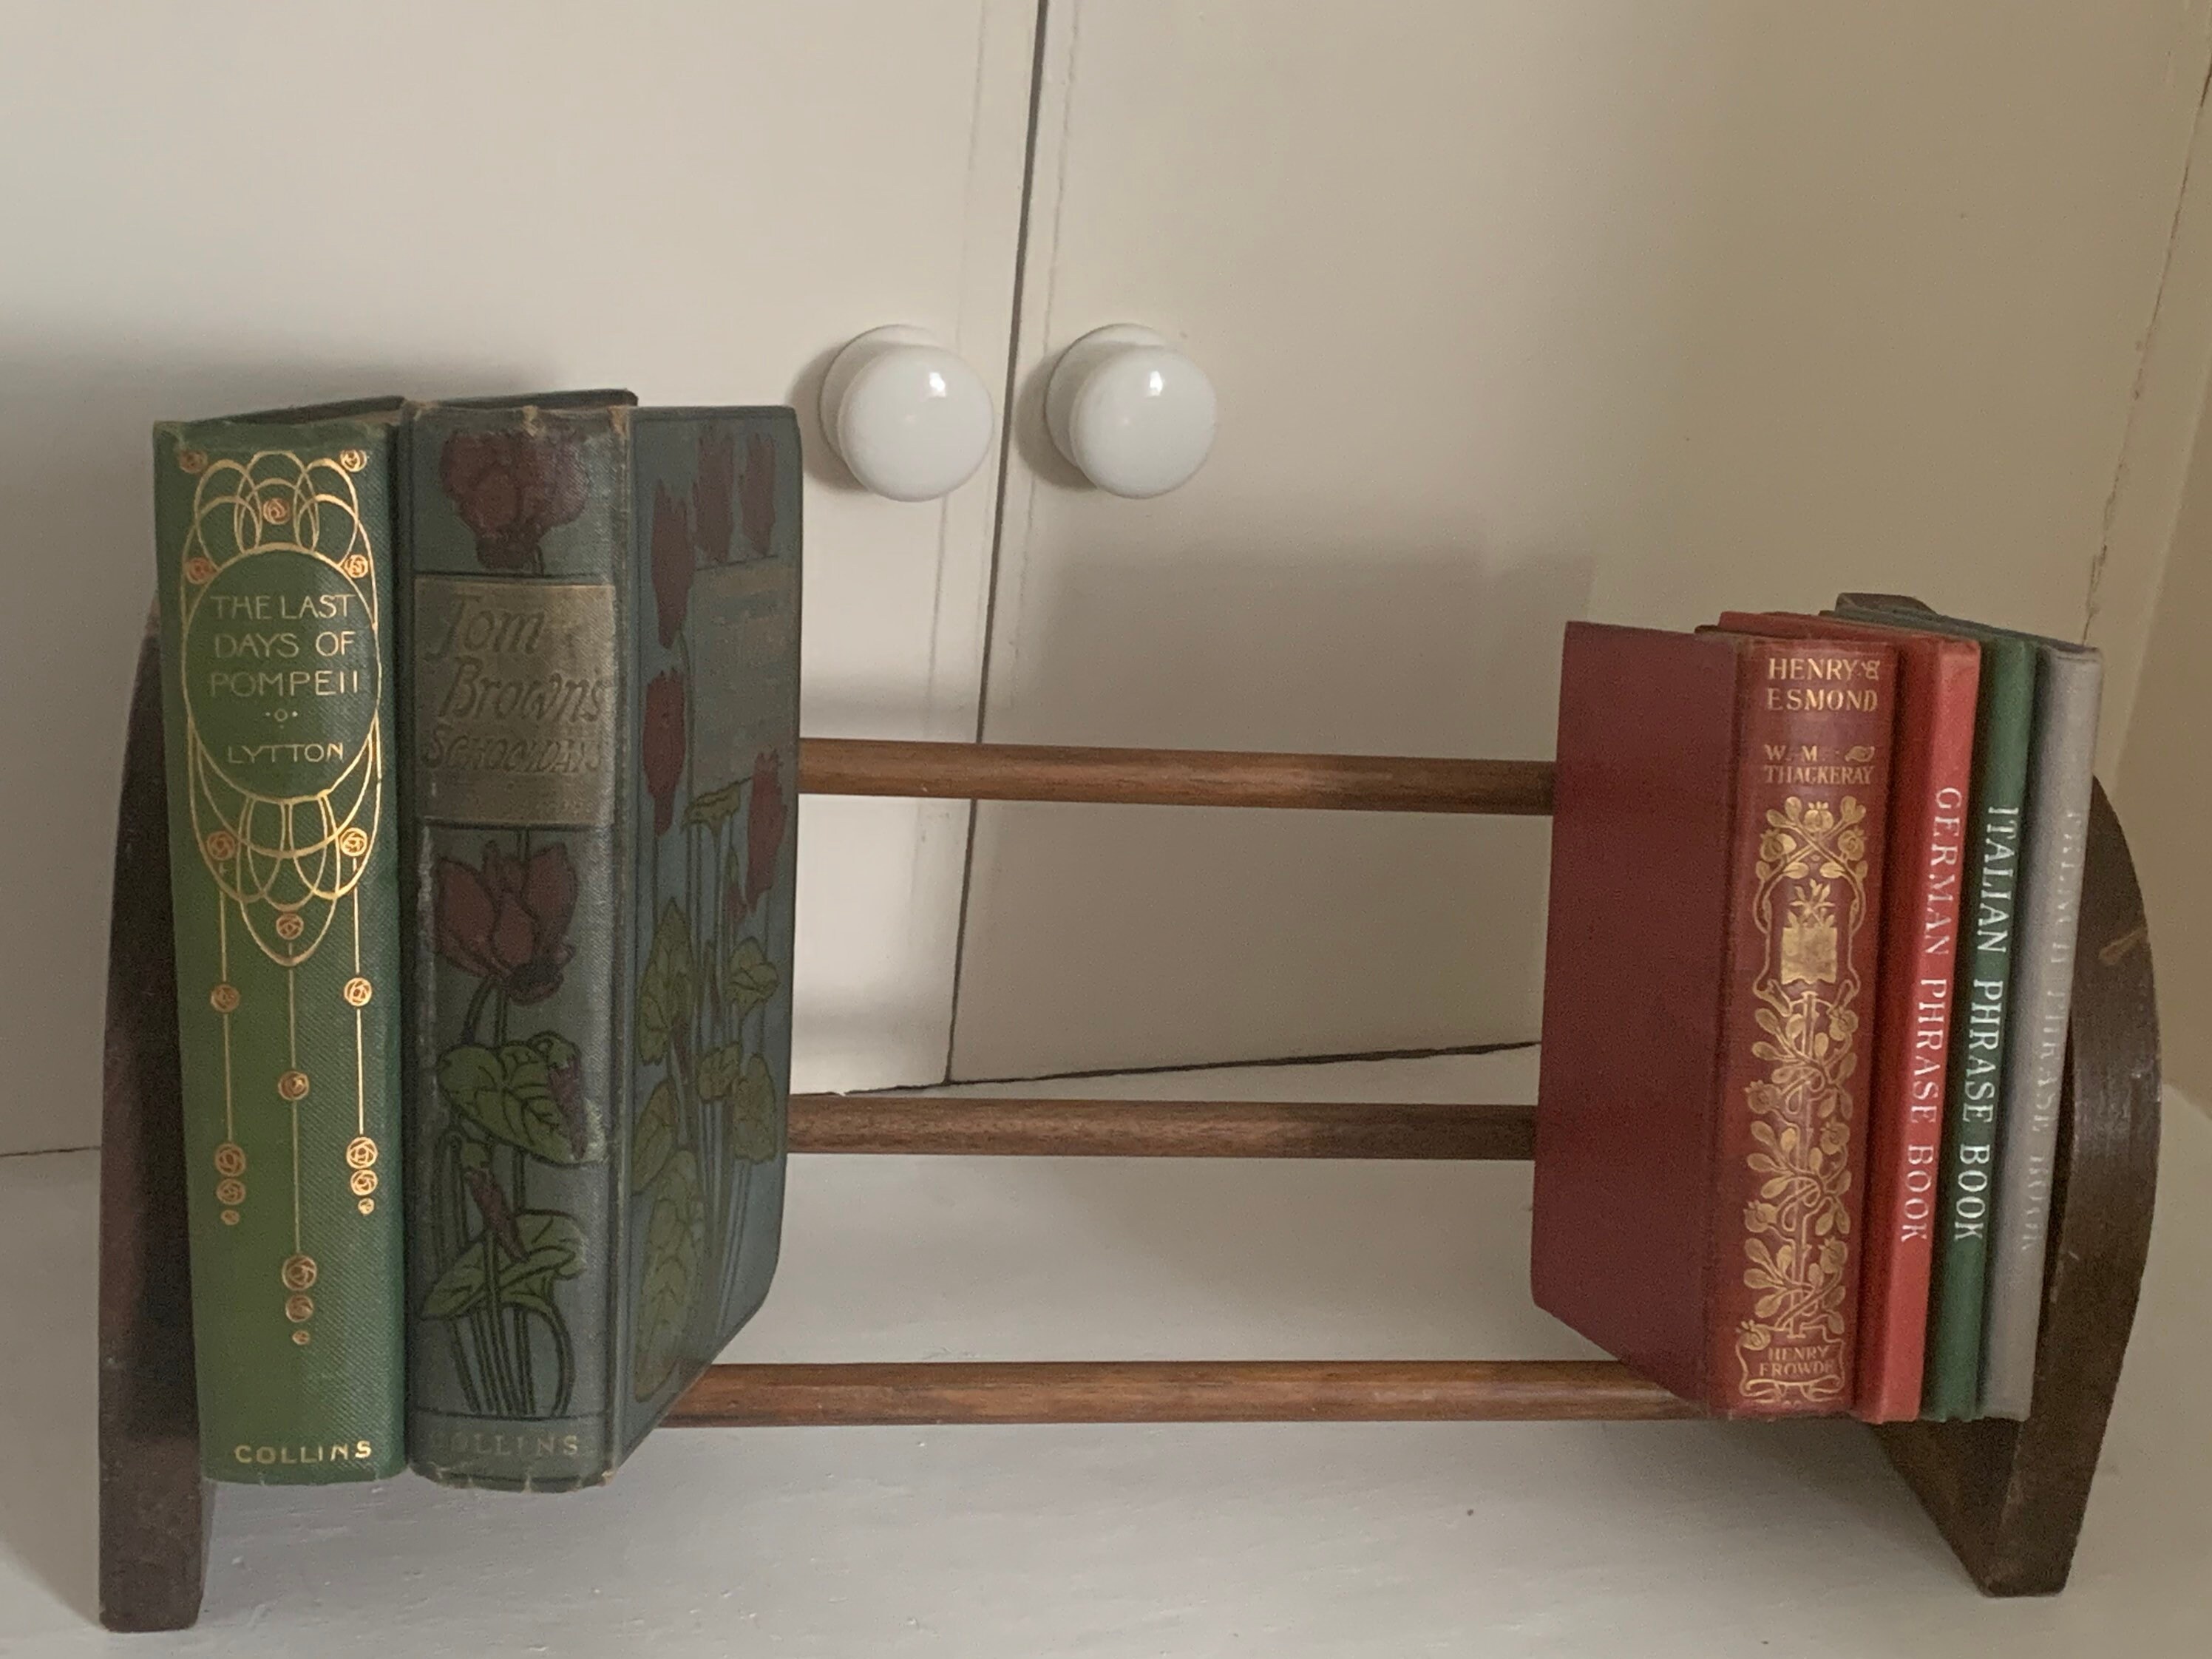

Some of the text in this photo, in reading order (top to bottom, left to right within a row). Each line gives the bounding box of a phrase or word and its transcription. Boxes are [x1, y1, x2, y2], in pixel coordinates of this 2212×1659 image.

[210, 594, 355, 620] THE LAST
[423, 594, 546, 660] Tom
[214, 631, 355, 658] DAYS OF
[1767, 657, 1857, 681] HENRY
[209, 671, 359, 698] POMPEII
[1767, 688, 1879, 712] ESMOND
[228, 742, 344, 764] LYTTON
[1764, 765, 1875, 784] THACKERAY
[1901, 787, 1963, 1242] GERMAN PHRASE BOOK
[1954, 806, 2019, 1241] ITALIAN PHRASE BOOK
[1768, 1345, 1829, 1361] HENRY
[1759, 1360, 1835, 1377] FROWDE
[234, 1440, 371, 1465] COLLINS
